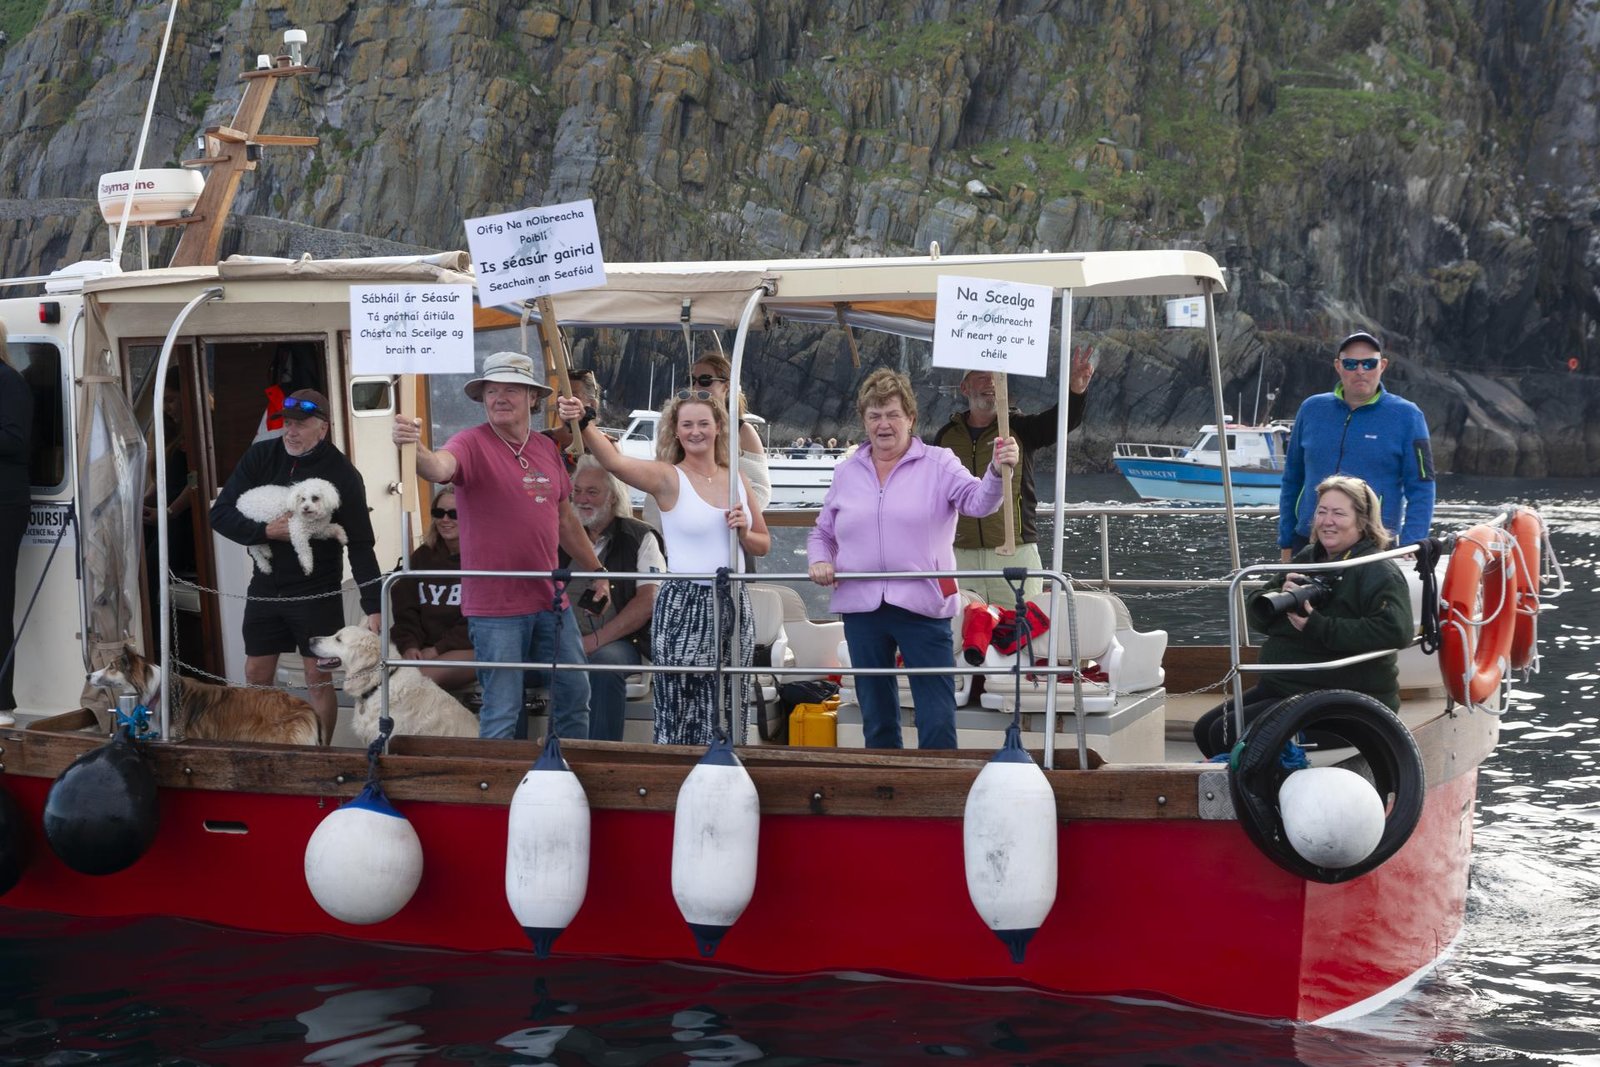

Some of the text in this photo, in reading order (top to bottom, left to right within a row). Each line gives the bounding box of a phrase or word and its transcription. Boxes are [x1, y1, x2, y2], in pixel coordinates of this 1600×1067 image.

[101, 180, 155, 195] Raymaine
[476, 210, 584, 235] Oifig Na nOibreacha
[519, 231, 548, 245] Poiblí
[480, 242, 595, 274] Is séasúr gairid
[489, 264, 594, 292] Seachain an Seafóid
[361, 291, 460, 304] Sábháil ár Séasúr
[956, 286, 1035, 311] Na Scealga
[367, 311, 455, 324] Tá gnóthaí áitiúla
[956, 310, 1033, 328] ár n-Oidhreacht
[360, 328, 464, 340] Chósta na Sceilge ag
[951, 328, 1036, 346] Ní neart go cur le
[385, 344, 436, 355] braith ar.
[980, 348, 1008, 360] chéile
